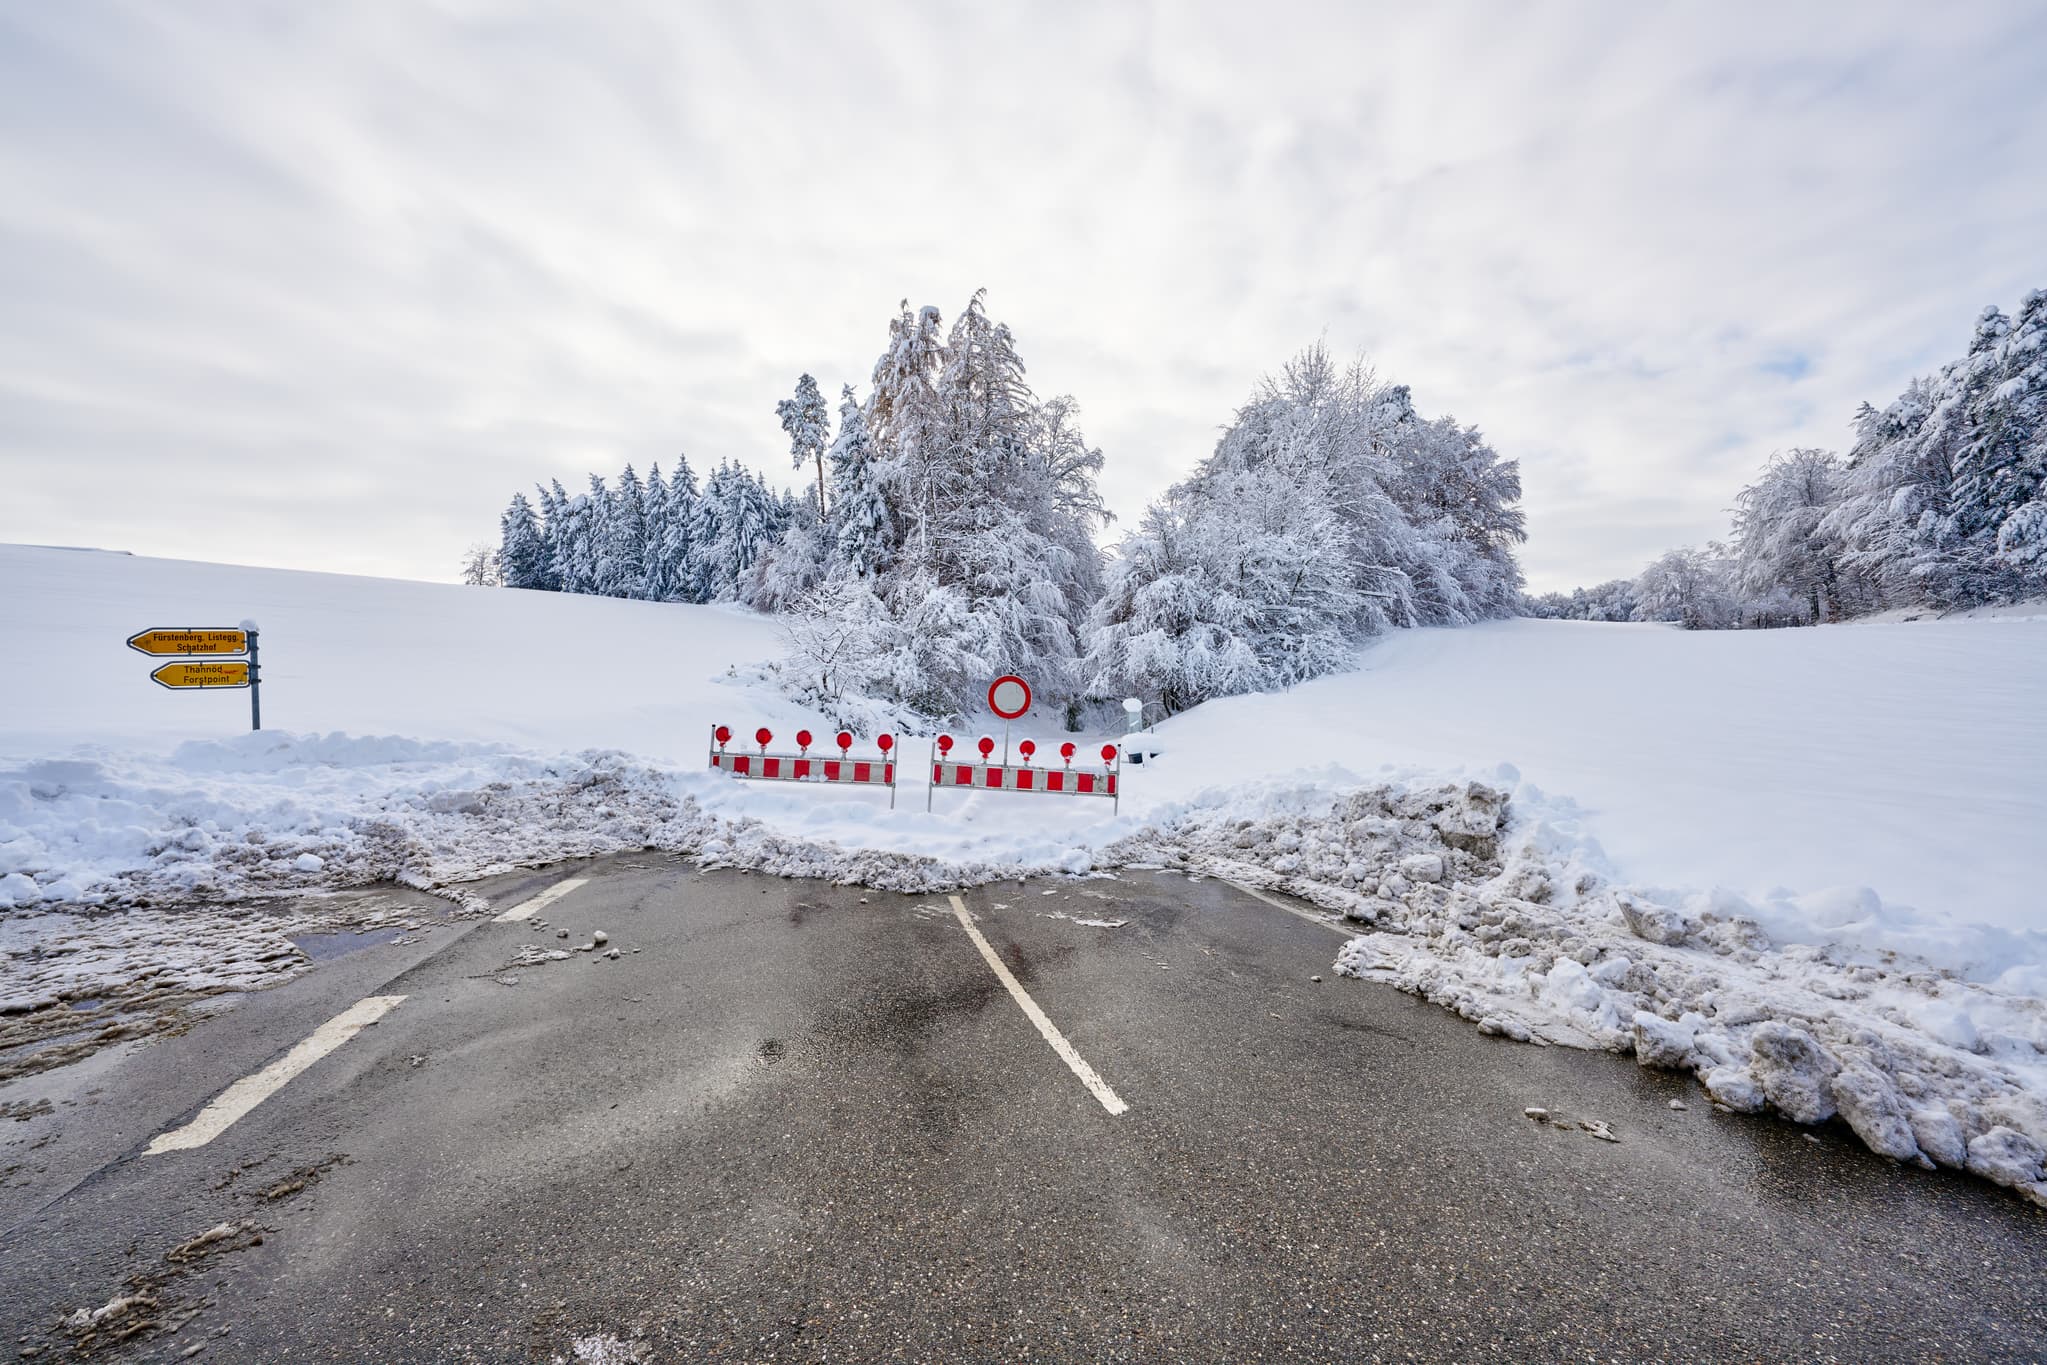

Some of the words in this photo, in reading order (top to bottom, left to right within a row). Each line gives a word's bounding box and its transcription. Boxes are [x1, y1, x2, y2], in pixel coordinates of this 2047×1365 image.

[177, 643, 217, 651] Schatzhof
[184, 665, 223, 674] Thannöd
[183, 675, 230, 684] Forstpoint
